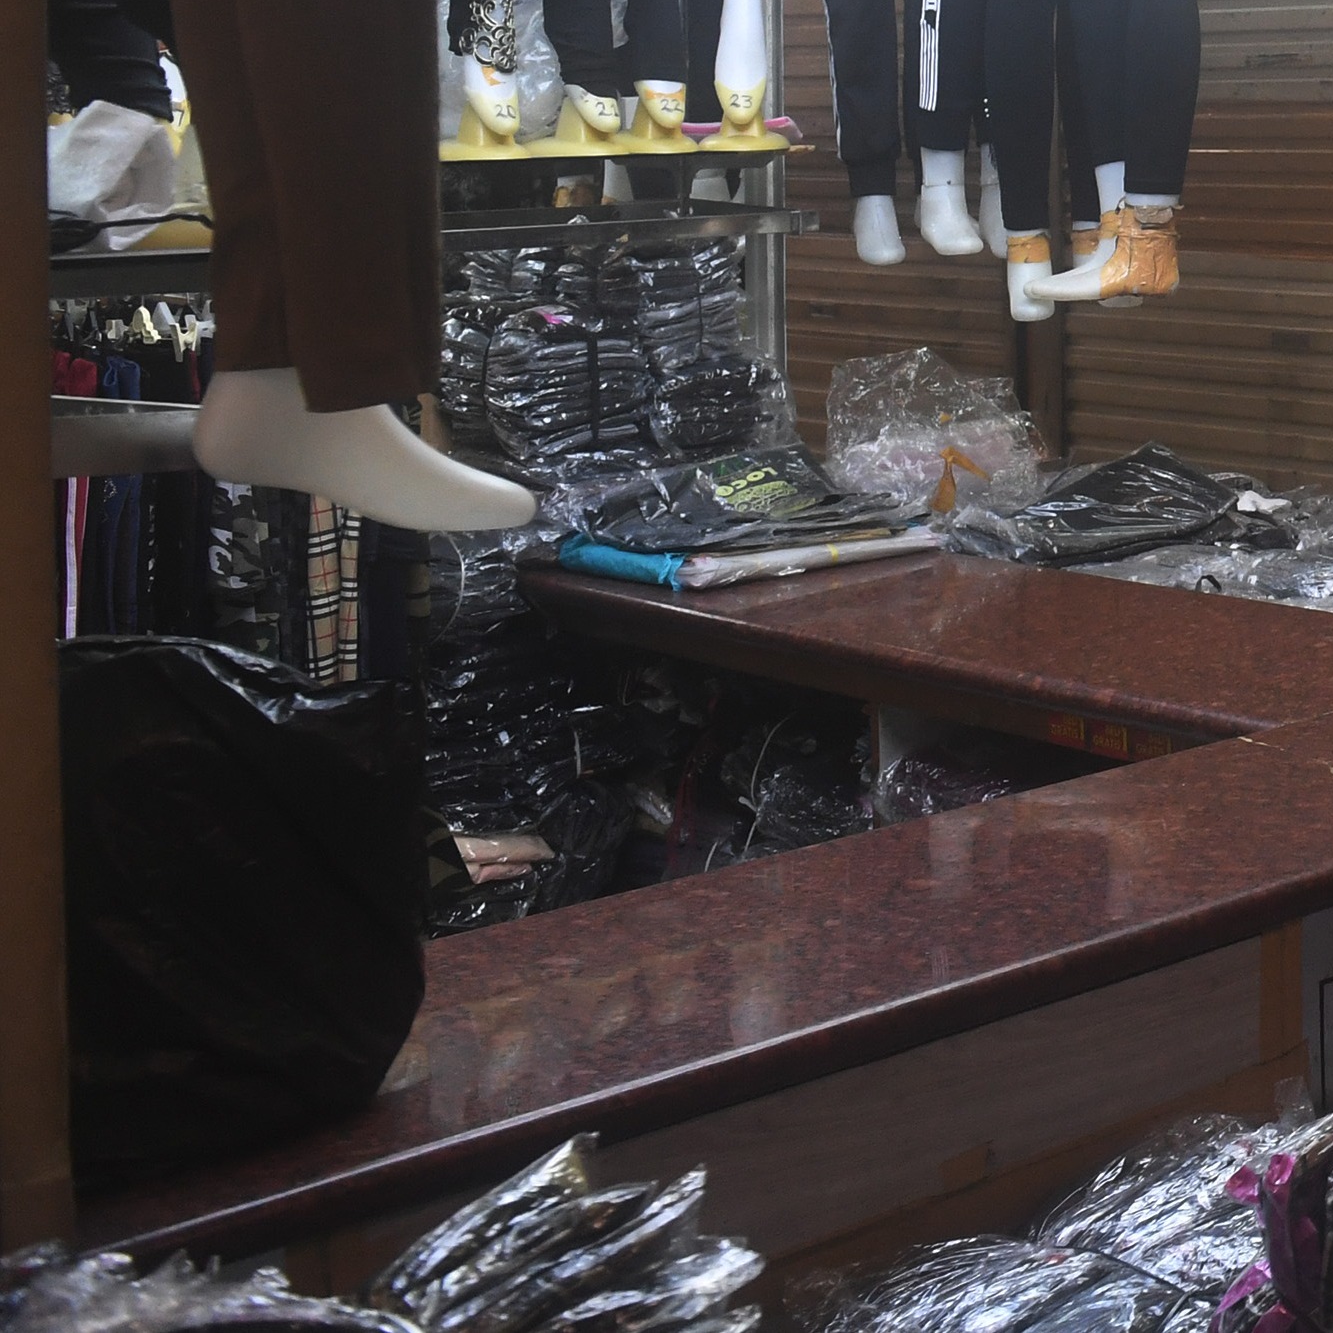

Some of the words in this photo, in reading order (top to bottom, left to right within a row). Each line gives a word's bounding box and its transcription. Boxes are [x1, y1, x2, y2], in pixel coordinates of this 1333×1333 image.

[660, 98, 684, 114] 22
[729, 93, 753, 109] 23
[495, 104, 516, 119] 20
